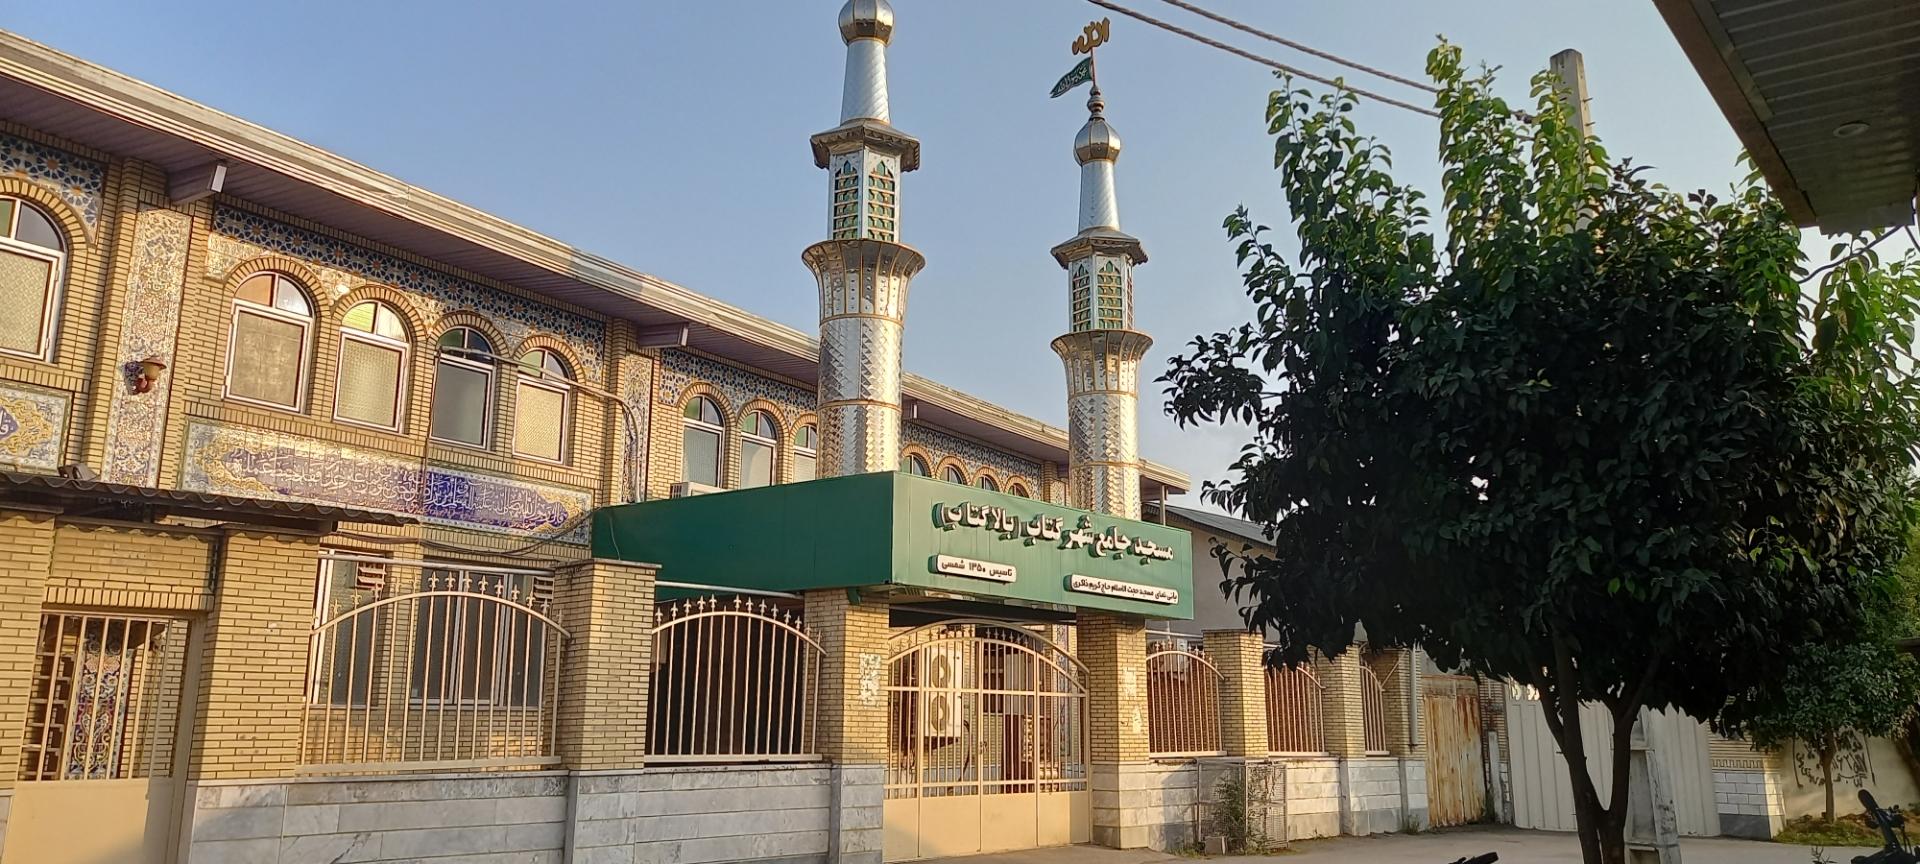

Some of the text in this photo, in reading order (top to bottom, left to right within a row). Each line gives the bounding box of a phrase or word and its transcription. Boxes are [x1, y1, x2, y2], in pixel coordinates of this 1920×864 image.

[1072, 17, 1110, 55] الله
[1064, 515, 1095, 549] شهر
[1093, 526, 1132, 557] جامع
[1133, 536, 1174, 564] مسجد
[941, 559, 966, 570] شمسی
[968, 562, 986, 573] ۱۳۵۰
[1100, 582, 1111, 594] حاج
